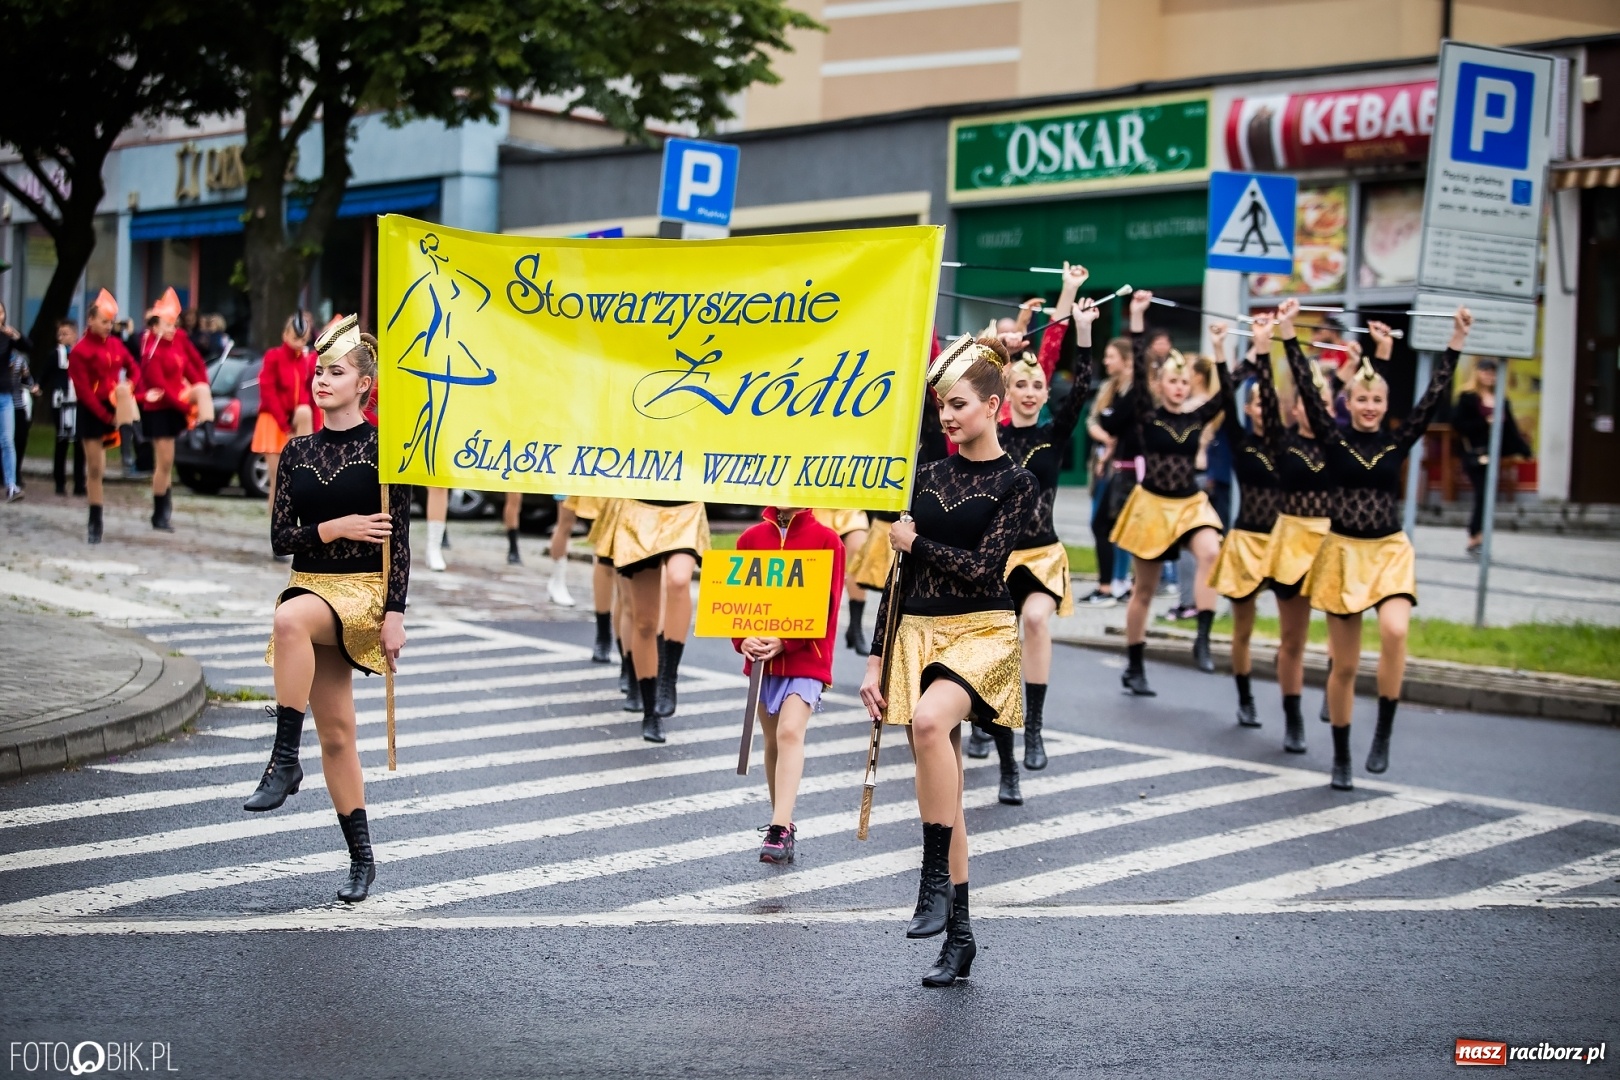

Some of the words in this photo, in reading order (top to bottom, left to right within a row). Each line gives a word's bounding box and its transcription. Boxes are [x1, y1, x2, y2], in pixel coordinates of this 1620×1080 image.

[1006, 114, 1148, 177] OSKAR
[1470, 77, 1516, 152] P
[678, 149, 722, 211] P
[506, 253, 840, 340] Stowarzyszenie
[633, 334, 896, 420] Źródło
[453, 429, 562, 480] ŚLĄSK
[568, 446, 683, 482] KRAINA
[703, 452, 790, 487] WIELU
[795, 454, 907, 490] KULTUR
[726, 556, 804, 588] ZARA
[711, 602, 772, 616] POWIAT
[732, 617, 815, 632] RACIBÓRZ
